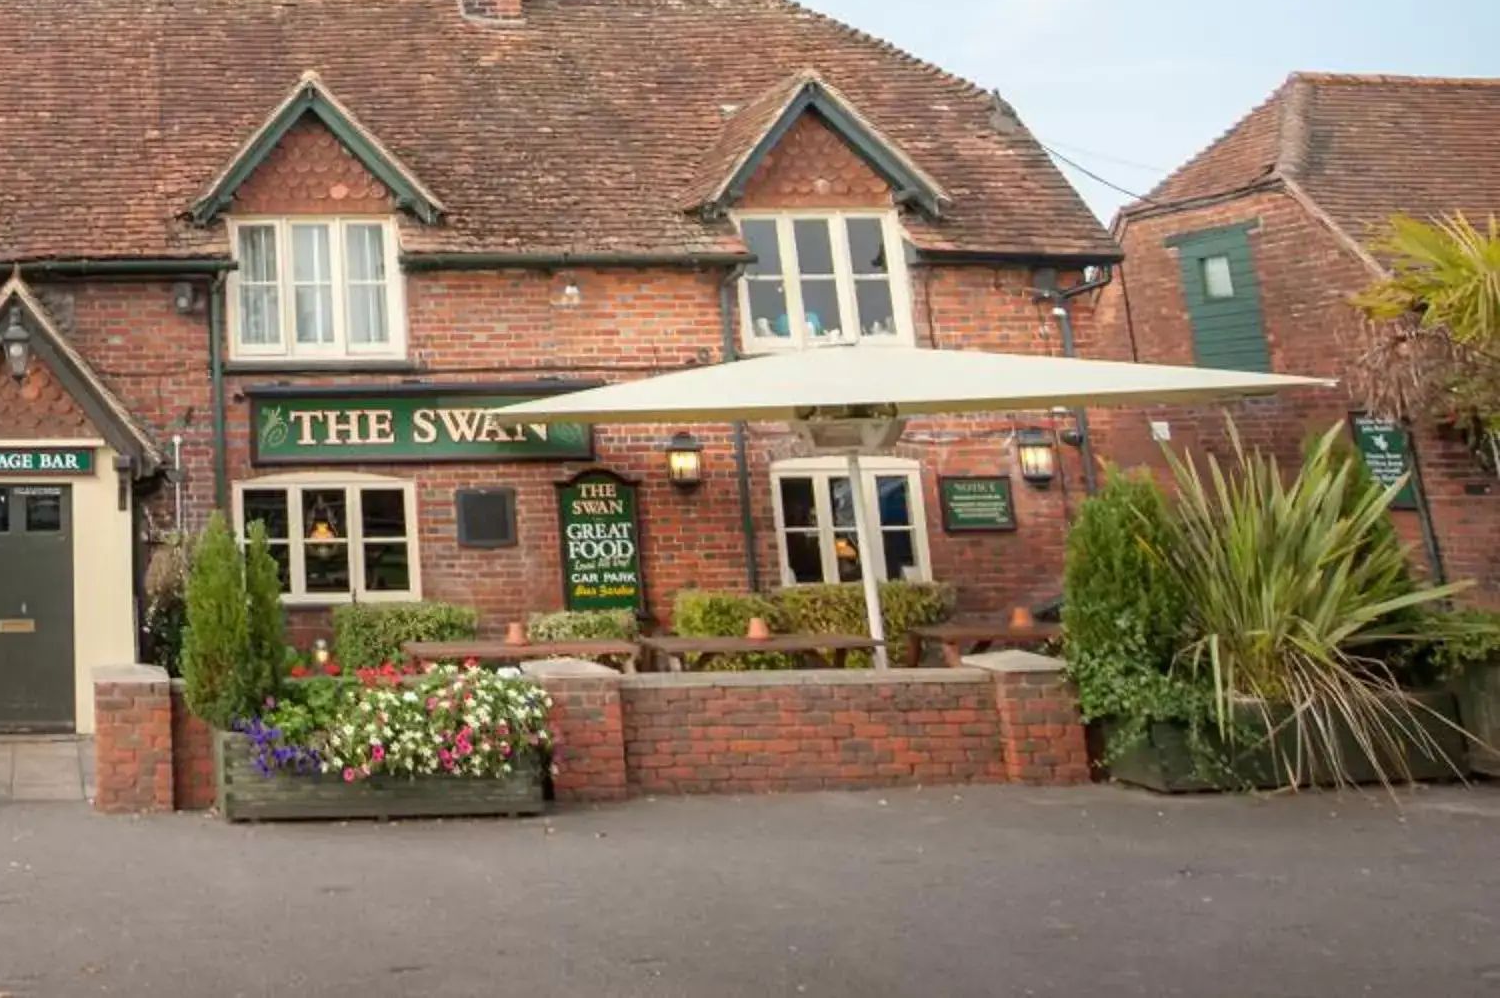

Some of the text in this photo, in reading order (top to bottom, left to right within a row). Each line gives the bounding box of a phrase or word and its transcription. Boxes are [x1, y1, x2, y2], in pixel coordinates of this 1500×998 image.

[289, 409, 395, 445] THE
[39, 454, 80, 469] BAR
[576, 483, 617, 498] THE
[571, 500, 624, 515] SWAN
[566, 523, 633, 539] GREAT
[568, 540, 635, 558] FOOD
[571, 572, 637, 583] CAR PARK
